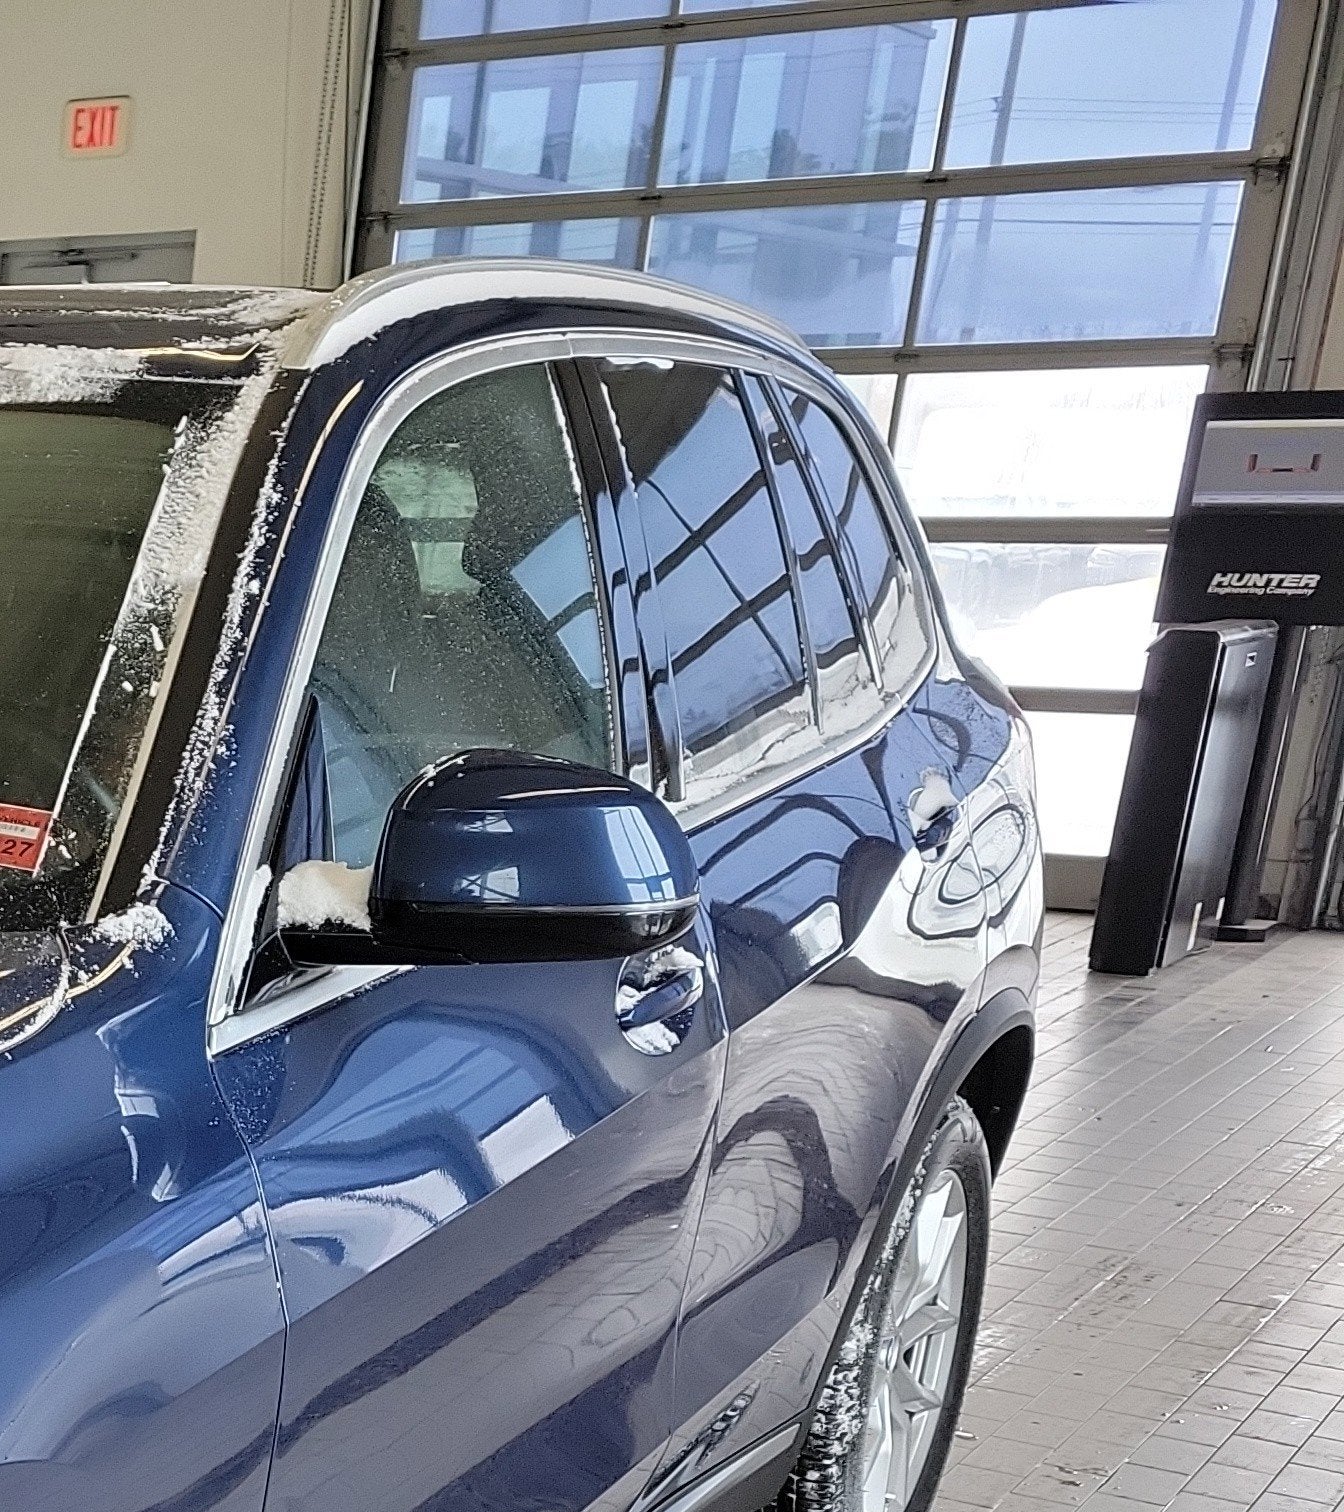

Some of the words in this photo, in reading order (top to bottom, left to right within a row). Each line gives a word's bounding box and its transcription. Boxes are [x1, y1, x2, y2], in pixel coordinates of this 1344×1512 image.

[72, 105, 119, 149] EXIT
[1211, 572, 1321, 587] HUNTER
[1206, 585, 1265, 596] Engineering
[1266, 586, 1315, 597] Company
[0, 839, 35, 858] 27
